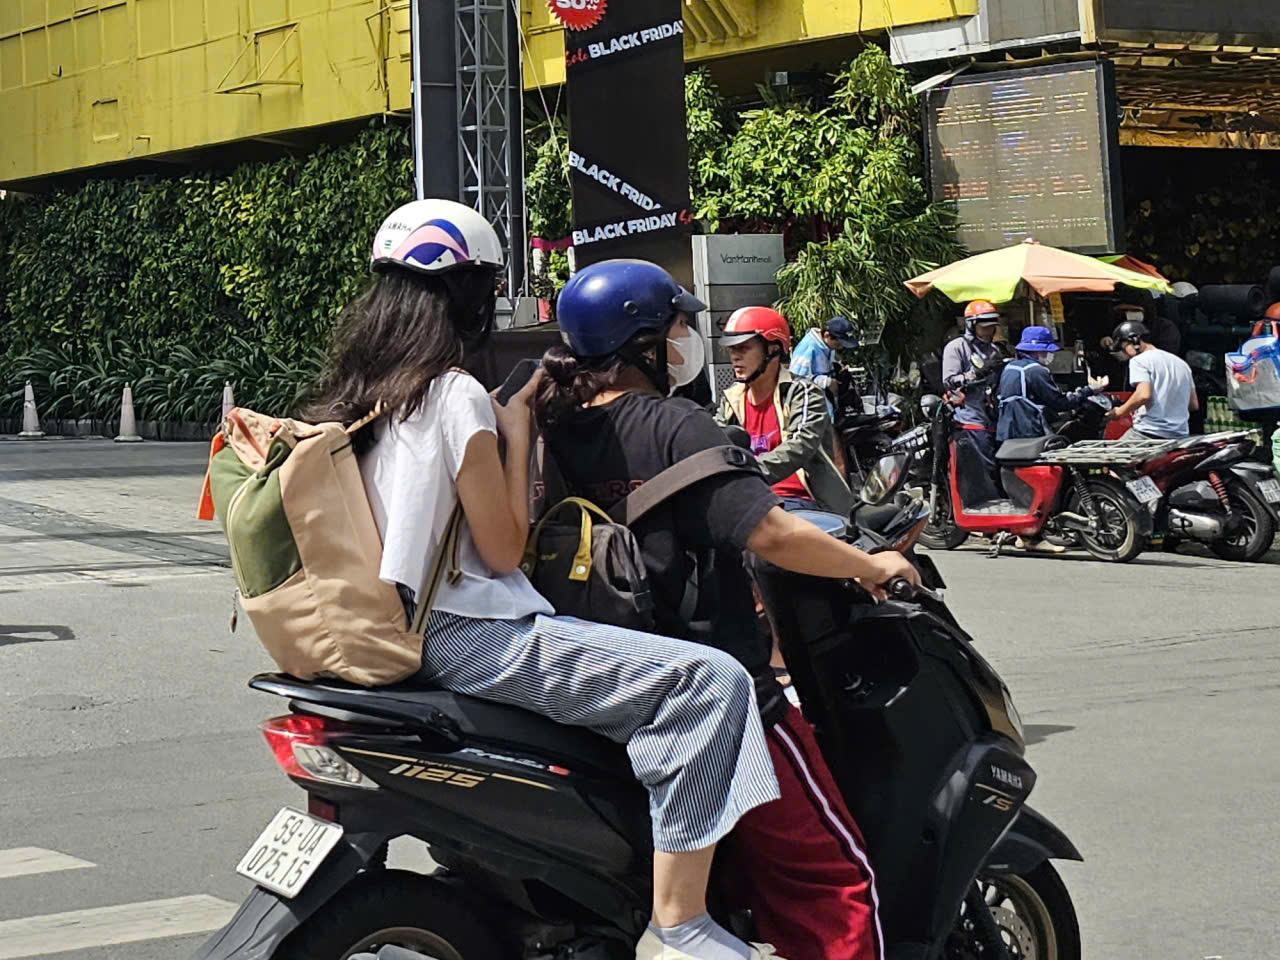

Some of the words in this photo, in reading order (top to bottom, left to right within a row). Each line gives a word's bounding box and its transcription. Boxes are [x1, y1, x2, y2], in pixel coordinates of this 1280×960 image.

[587, 31, 642, 58] BLACK
[568, 150, 621, 192] BLACK
[572, 222, 628, 246] BLACK
[626, 212, 678, 234] FRIDAY
[274, 815, 328, 857] 59-UA
[246, 844, 310, 888] 075.15
